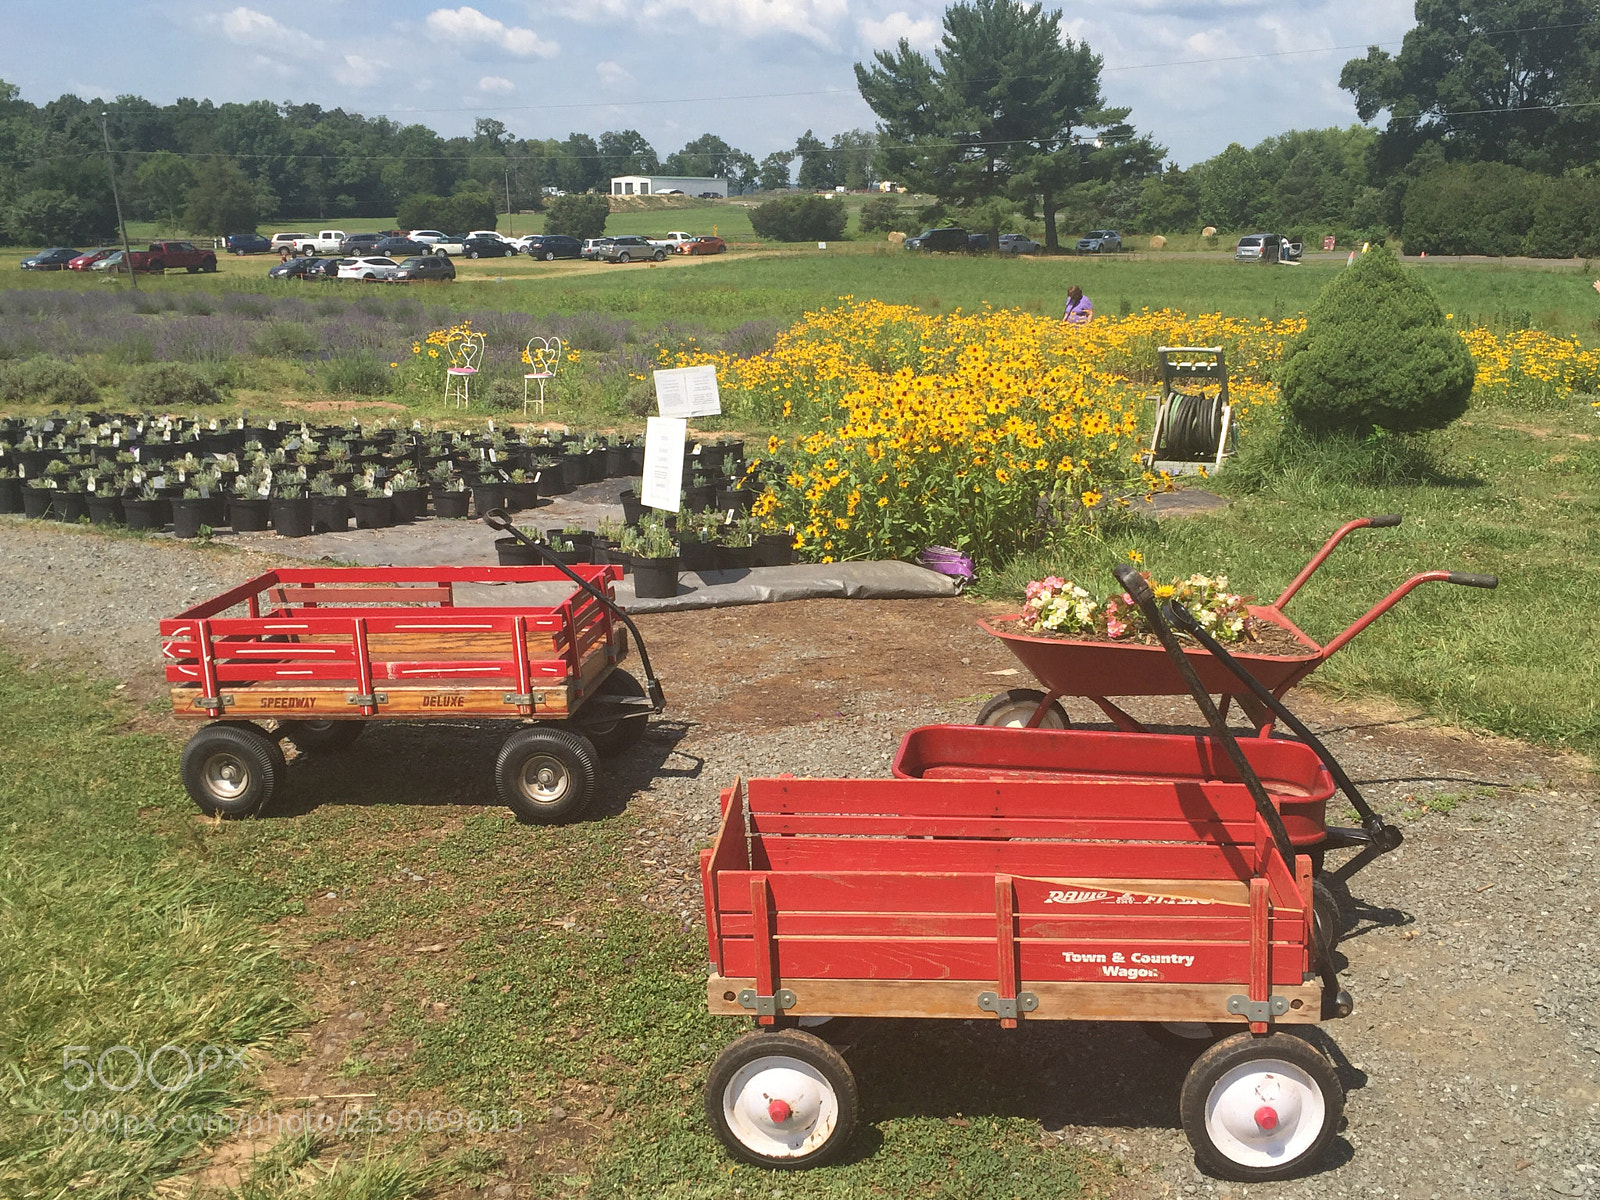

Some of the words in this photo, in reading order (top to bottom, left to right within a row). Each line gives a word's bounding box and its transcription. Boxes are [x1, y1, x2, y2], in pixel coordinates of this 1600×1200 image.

[260, 697, 317, 709] SPEEDWAY
[422, 695, 465, 708] DELUXE
[1062, 951, 1107, 964] Town
[1112, 952, 1126, 964] &
[1132, 952, 1195, 966] Country
